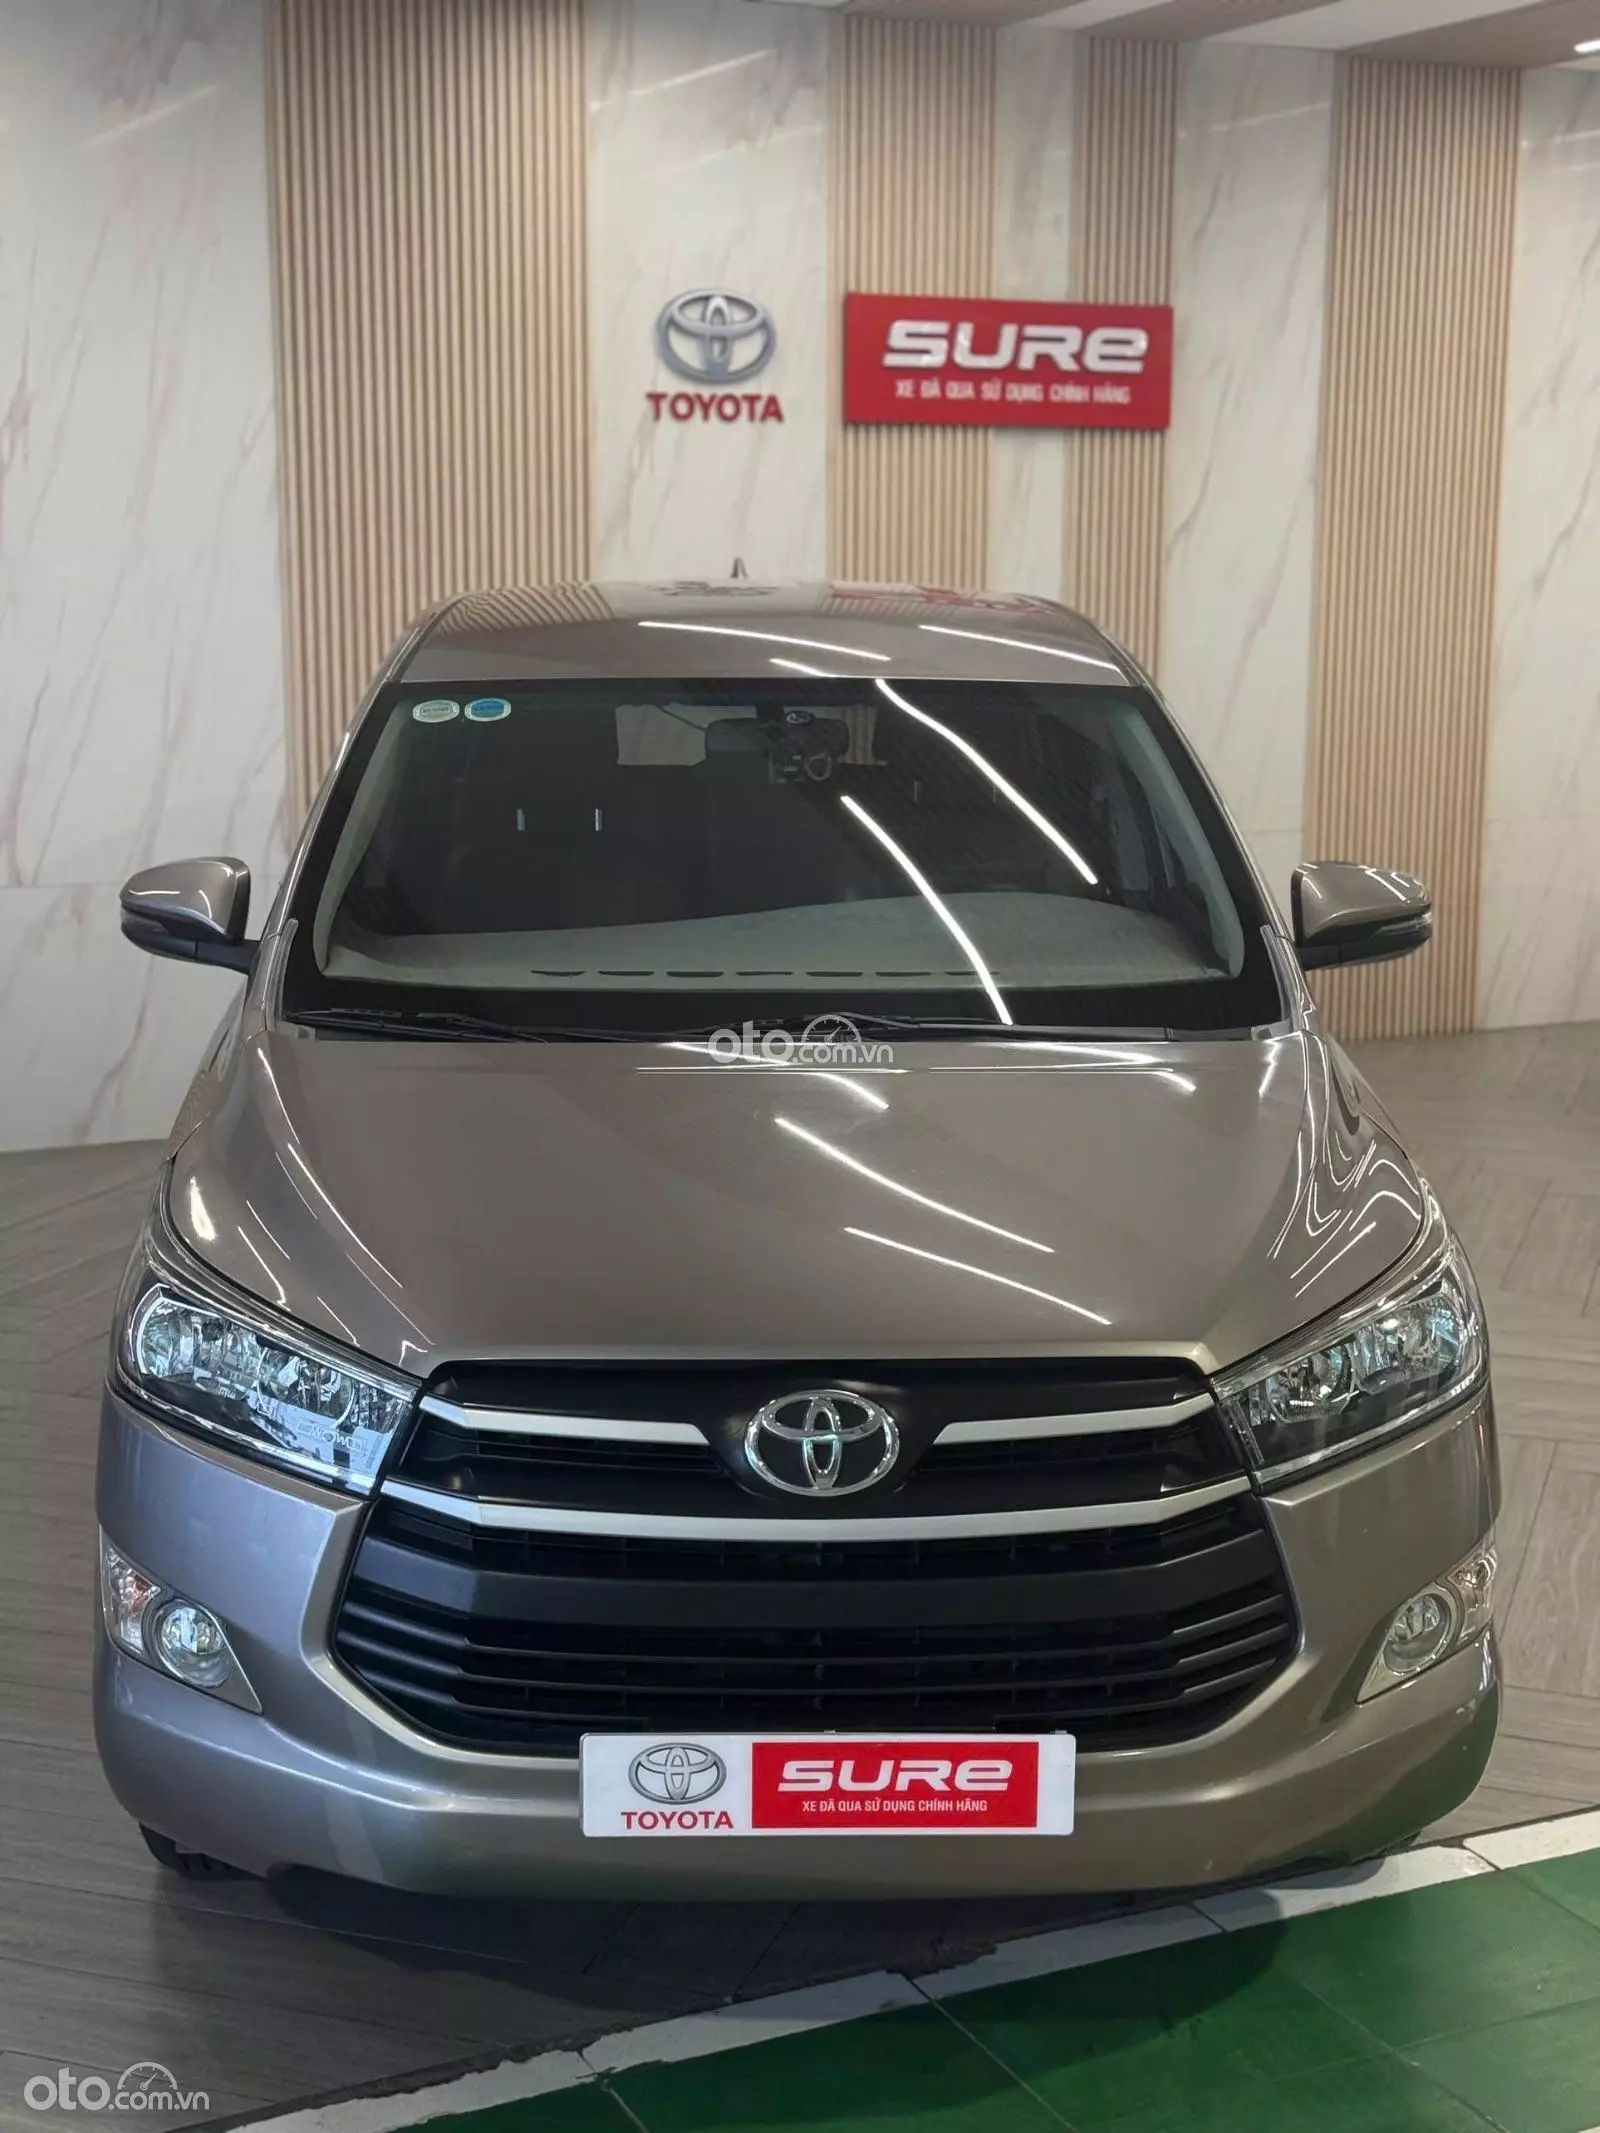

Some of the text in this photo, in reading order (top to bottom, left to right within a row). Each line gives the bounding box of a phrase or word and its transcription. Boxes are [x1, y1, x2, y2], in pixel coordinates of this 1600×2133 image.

[895, 379, 915, 399] XE
[646, 392, 784, 423] TOYOTA
[802, 1800, 817, 1812] XE
[838, 1800, 862, 1812] QUA
[883, 1800, 915, 1814] DỤNG
[918, 1797, 953, 1812] CHÍNH
[621, 1811, 734, 1830] TOYOTA
